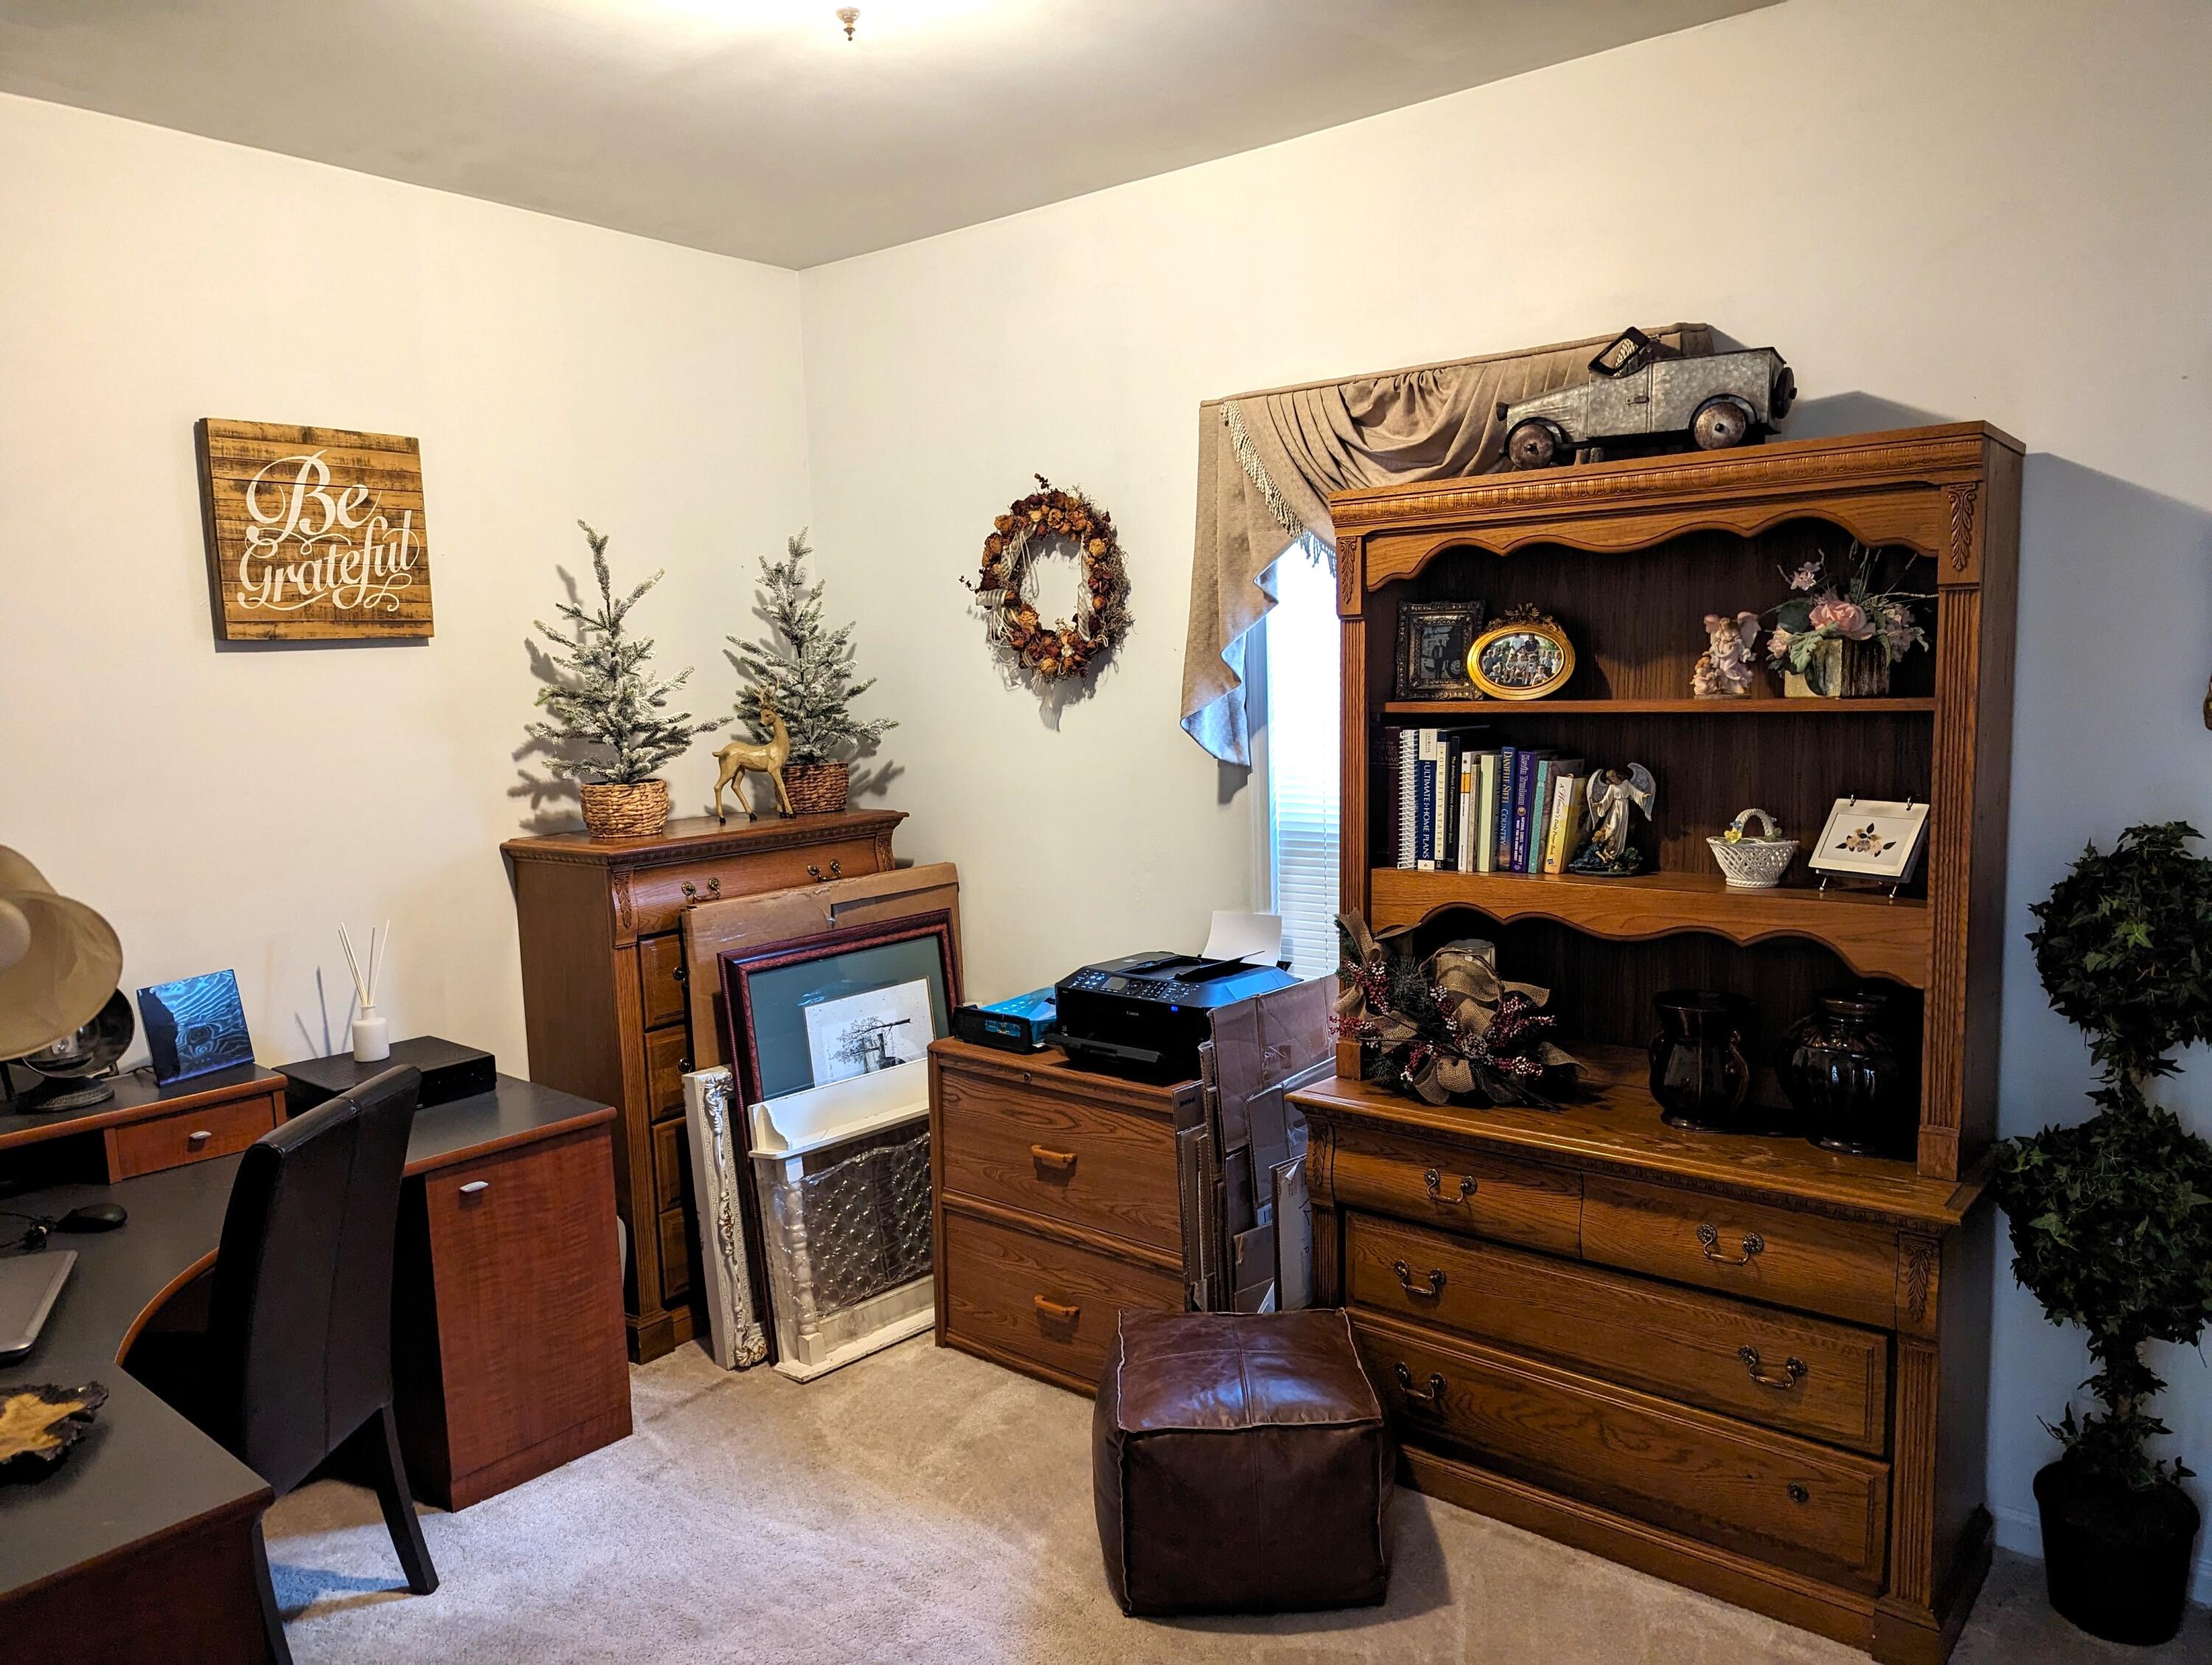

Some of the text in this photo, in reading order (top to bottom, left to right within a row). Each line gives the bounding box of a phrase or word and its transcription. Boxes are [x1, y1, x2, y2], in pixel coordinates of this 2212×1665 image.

[246, 449, 382, 543] Be
[237, 510, 420, 612] Grateful
[1423, 764, 1431, 802] ULTIMATE
[1518, 754, 1530, 805] Kevin Trudeau
[1422, 807, 1430, 832] HOME
[1554, 788, 1566, 818] Woman's
[1500, 808, 1509, 846] COUNTRY
